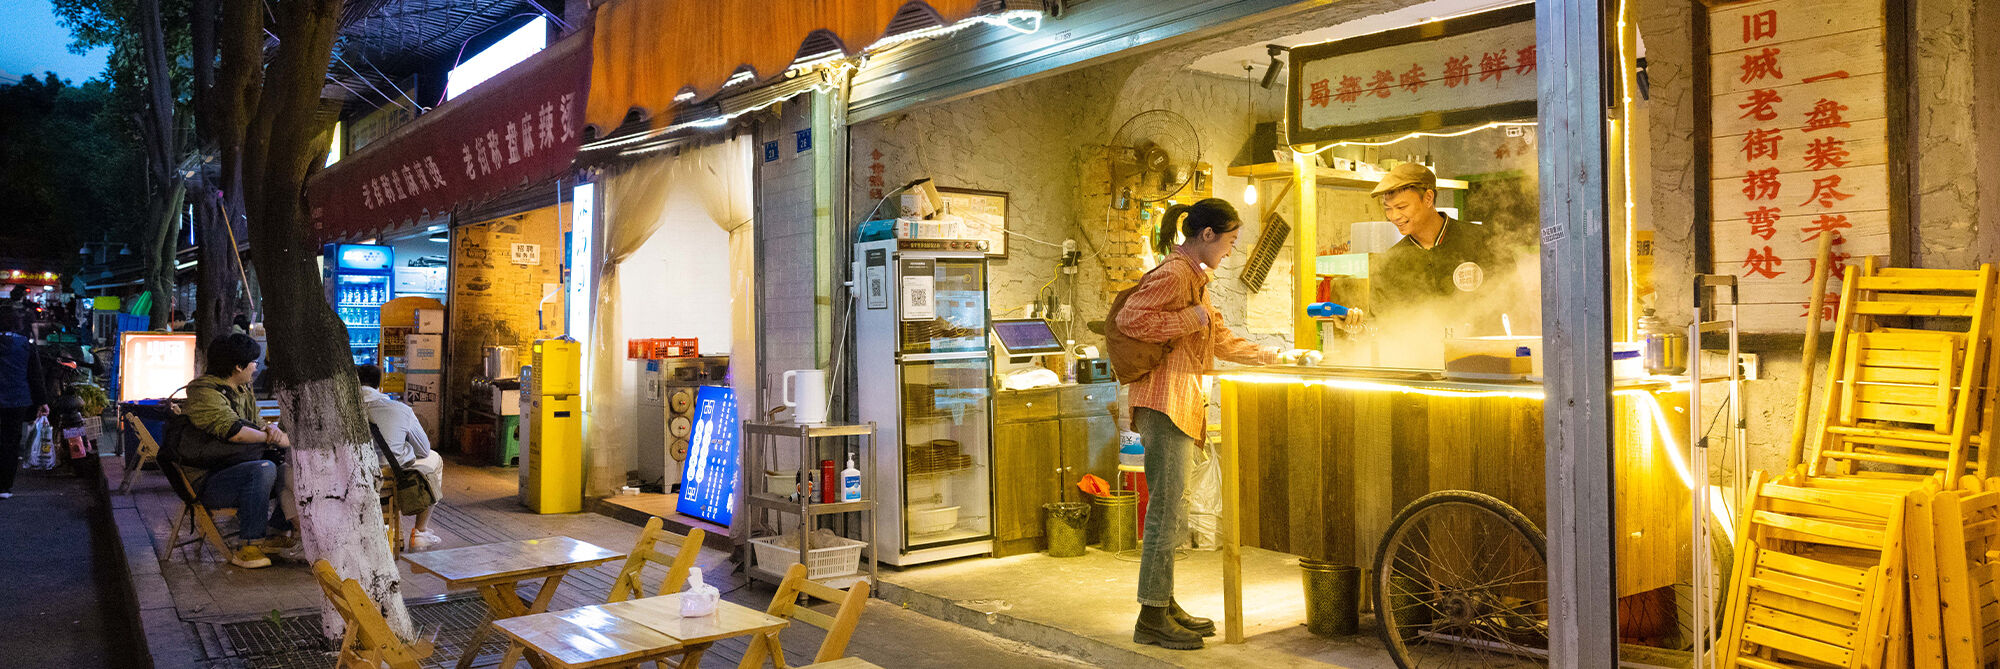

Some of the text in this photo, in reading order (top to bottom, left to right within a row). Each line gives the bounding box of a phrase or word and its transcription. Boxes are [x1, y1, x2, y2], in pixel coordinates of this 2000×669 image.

[1308, 63, 1428, 108] 蜀都老味
[1739, 9, 1786, 279] 旧城老街拐弯处
